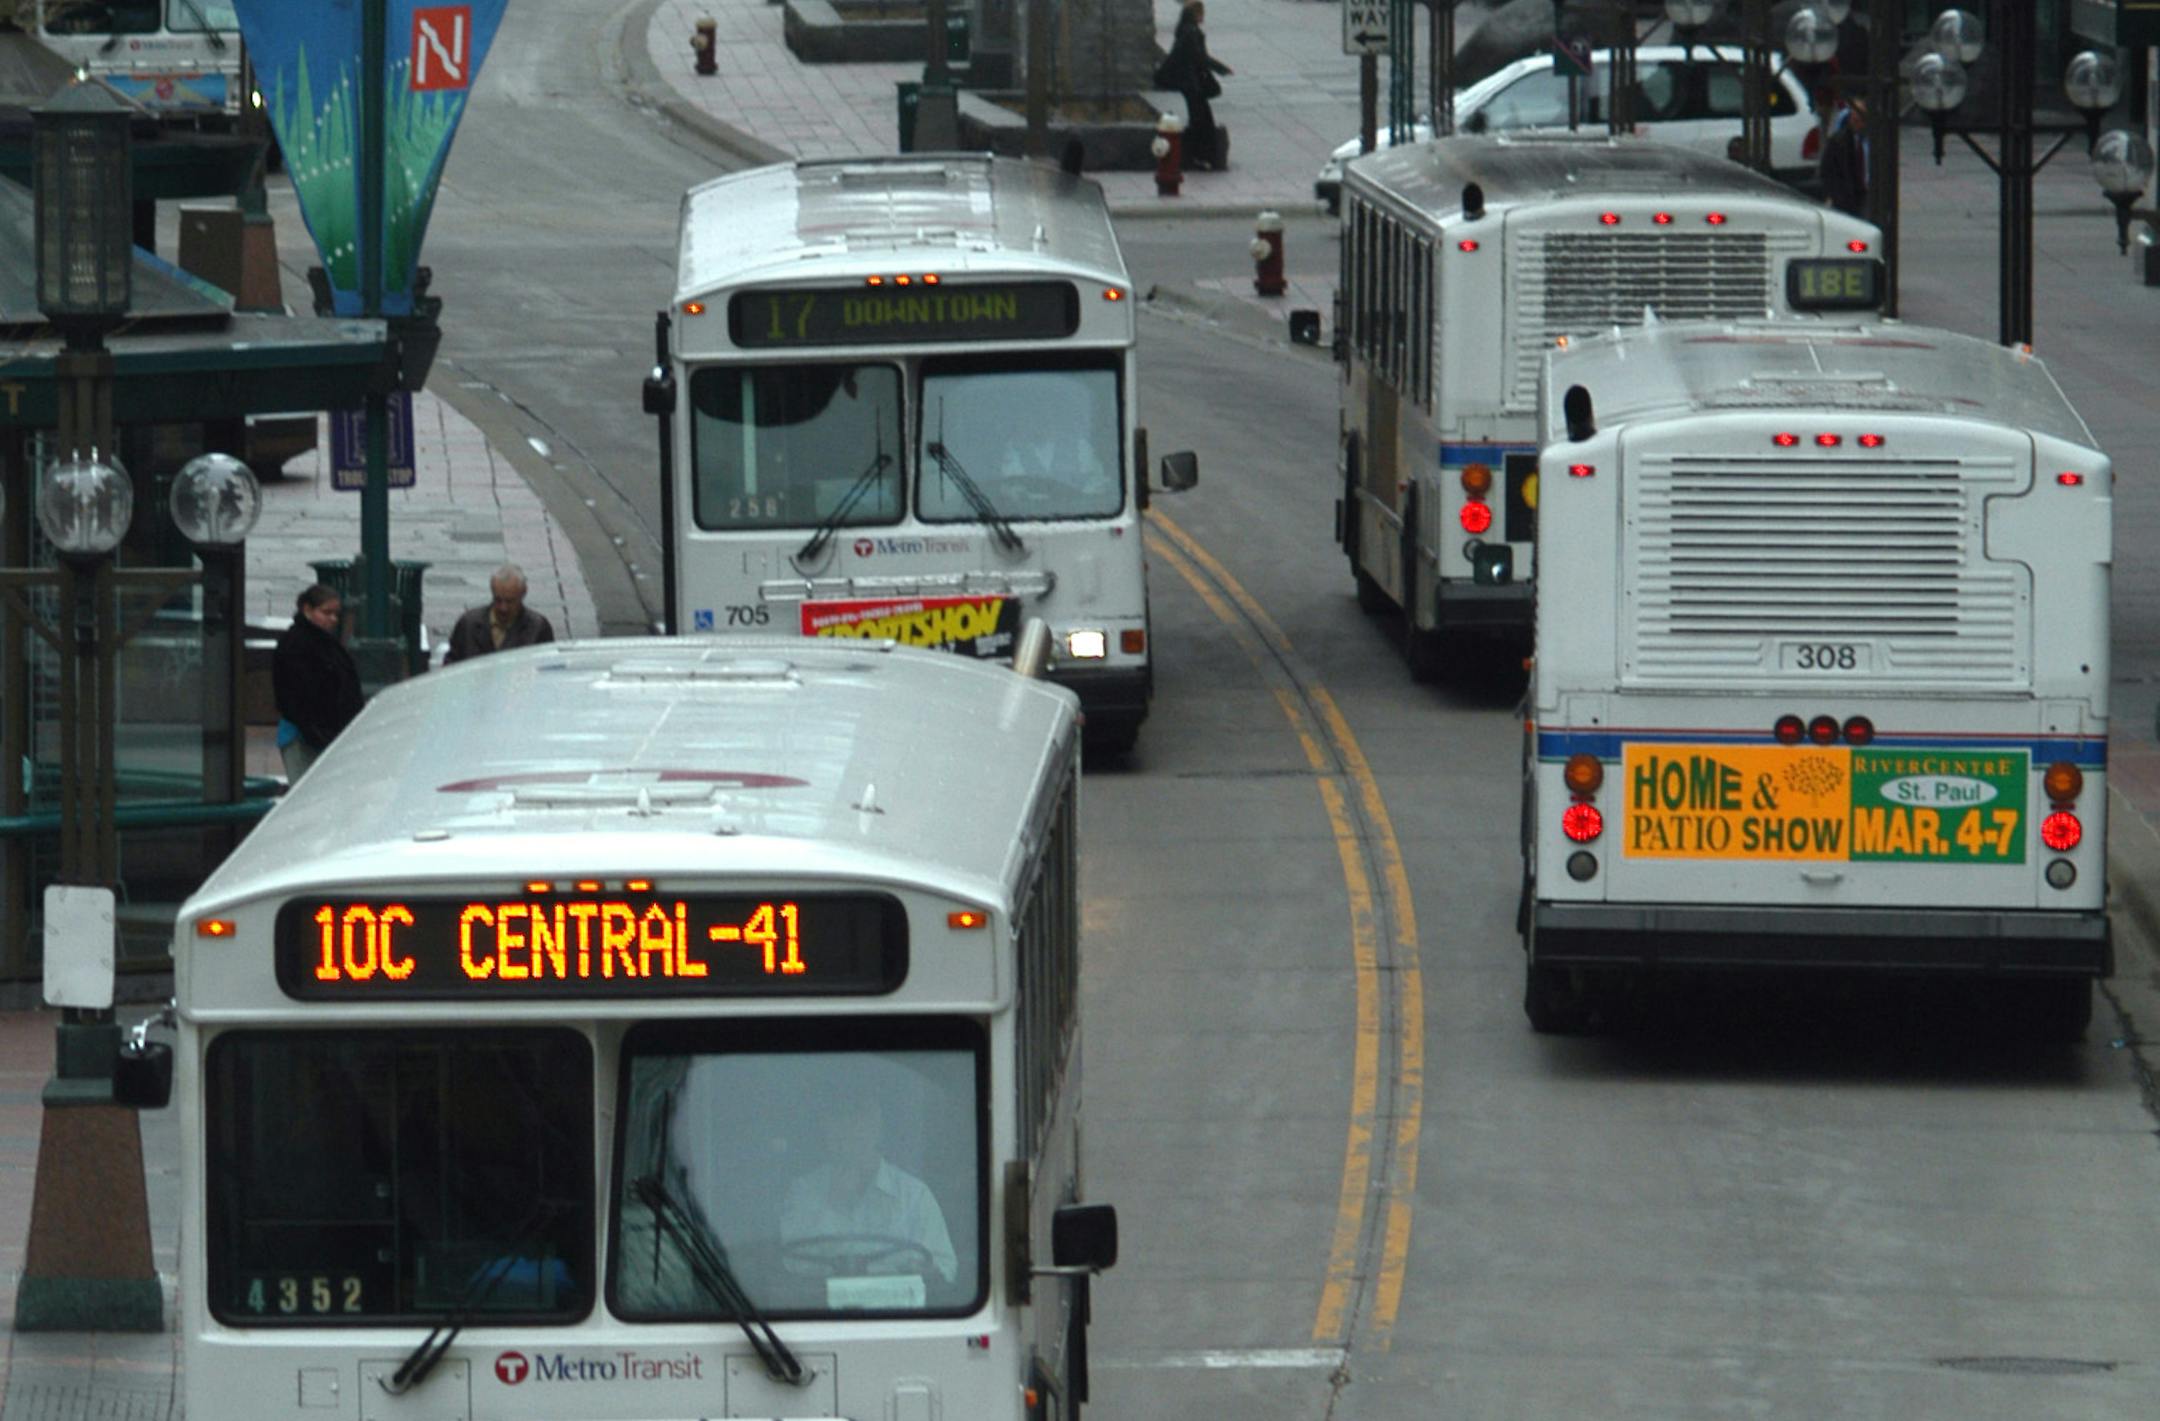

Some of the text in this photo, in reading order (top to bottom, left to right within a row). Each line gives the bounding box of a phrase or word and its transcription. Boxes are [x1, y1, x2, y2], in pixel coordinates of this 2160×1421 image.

[1350, 9, 1390, 26] WAY
[1802, 267, 1863, 298] 18E
[766, 294, 1017, 339] 17 DOWNTOWN
[726, 605, 769, 626] 705
[817, 597, 1003, 648] ORTSHOW
[1796, 644, 1856, 670] 308
[1634, 755, 1779, 811] HOME &
[1897, 781, 1981, 801] St. Paul
[1633, 815, 1843, 853] PATIO SHOW
[1854, 807, 2018, 855] MAR. 4-7
[315, 904, 416, 980] 10C
